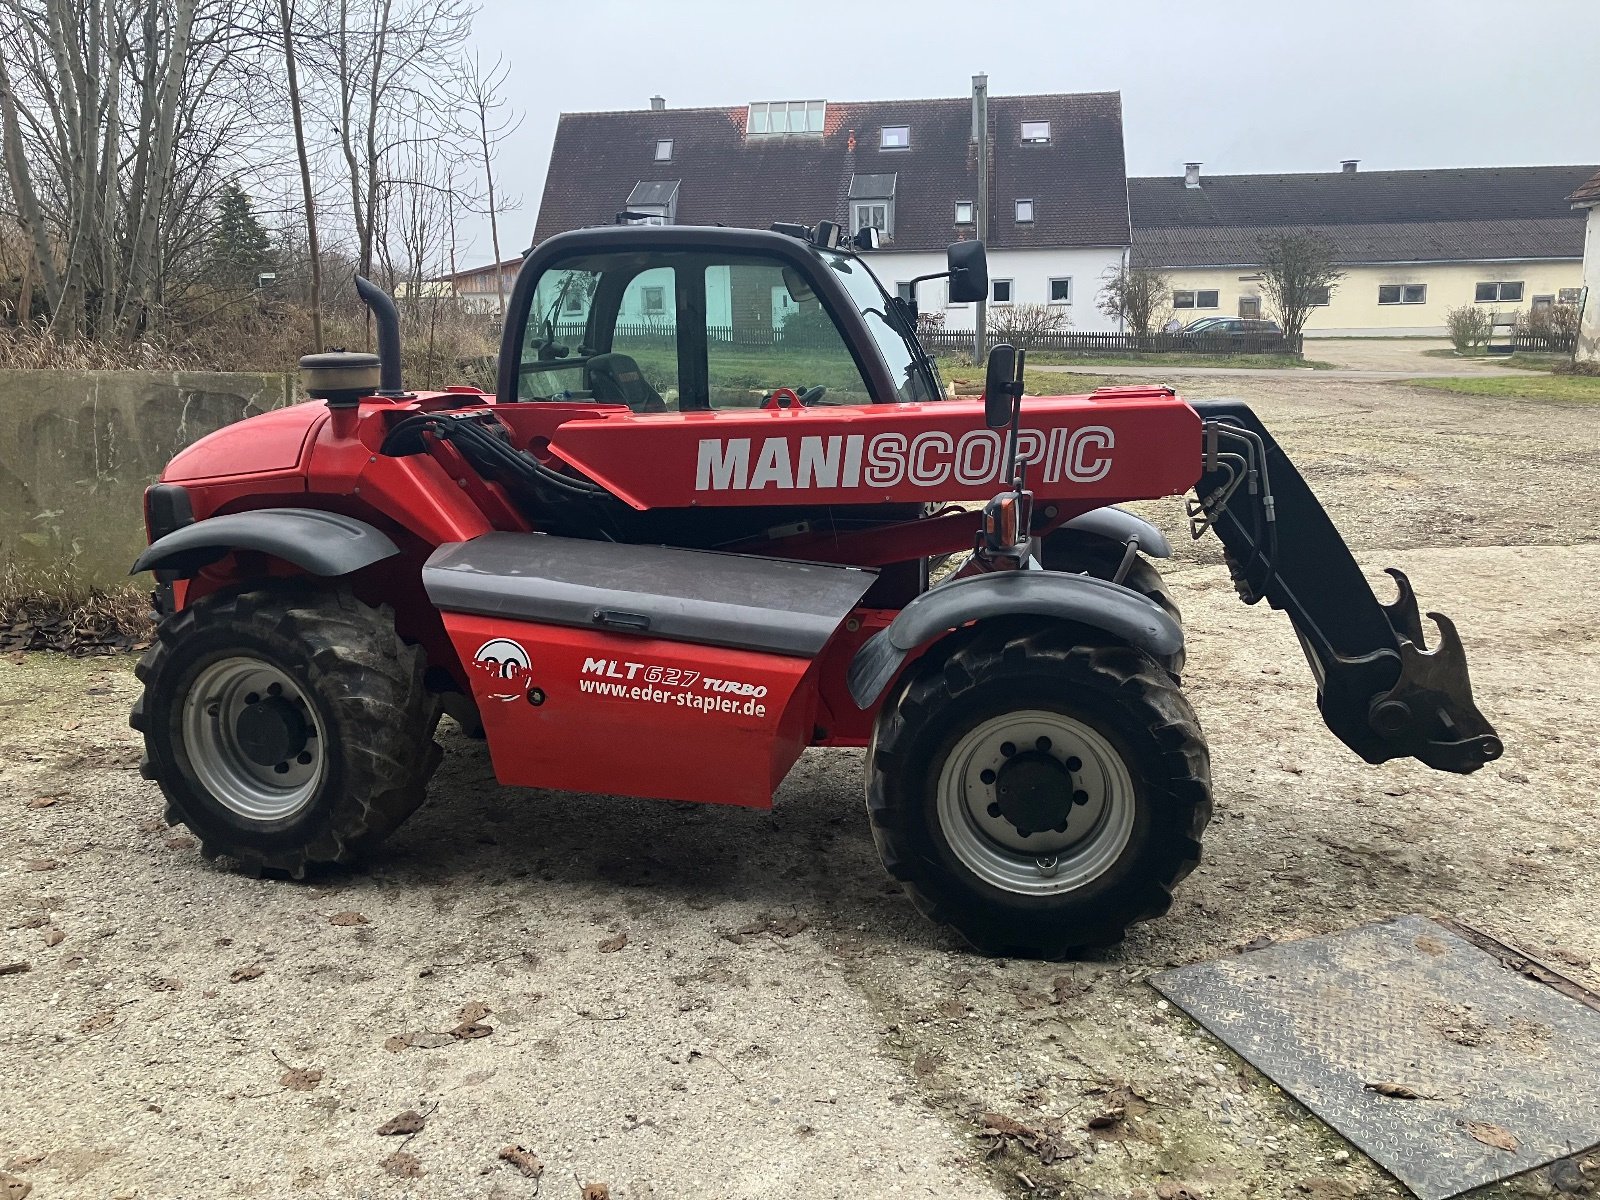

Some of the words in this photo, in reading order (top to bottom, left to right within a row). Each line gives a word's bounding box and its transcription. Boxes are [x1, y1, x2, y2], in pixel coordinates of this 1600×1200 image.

[695, 425, 1115, 491] MANISCOPIC
[581, 657, 644, 680] MLT
[643, 665, 700, 688] 627
[702, 677, 767, 698] TURBO
[579, 679, 766, 718] www.eder-stapler.de
